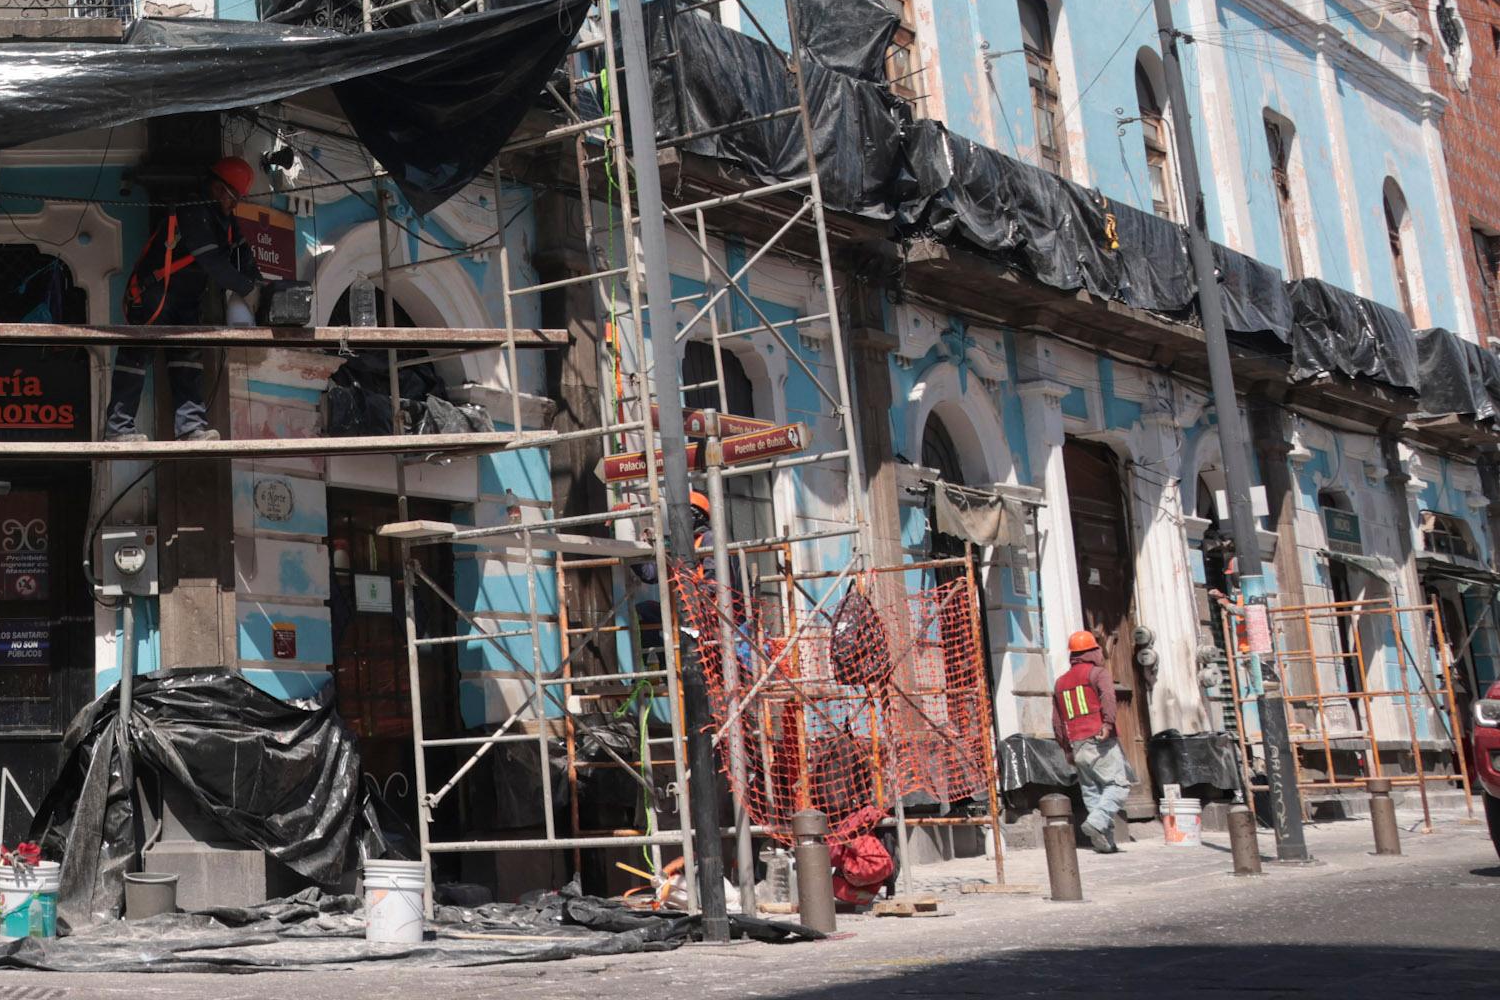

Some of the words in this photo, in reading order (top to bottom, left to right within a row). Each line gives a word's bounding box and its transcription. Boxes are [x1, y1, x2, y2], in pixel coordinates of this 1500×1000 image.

[257, 232, 272, 245] Calle
[258, 246, 279, 264] Norte
[734, 442, 756, 455] Puente
[757, 440, 765, 449] de
[766, 436, 786, 448] Bubas
[619, 460, 646, 472] Palacio
